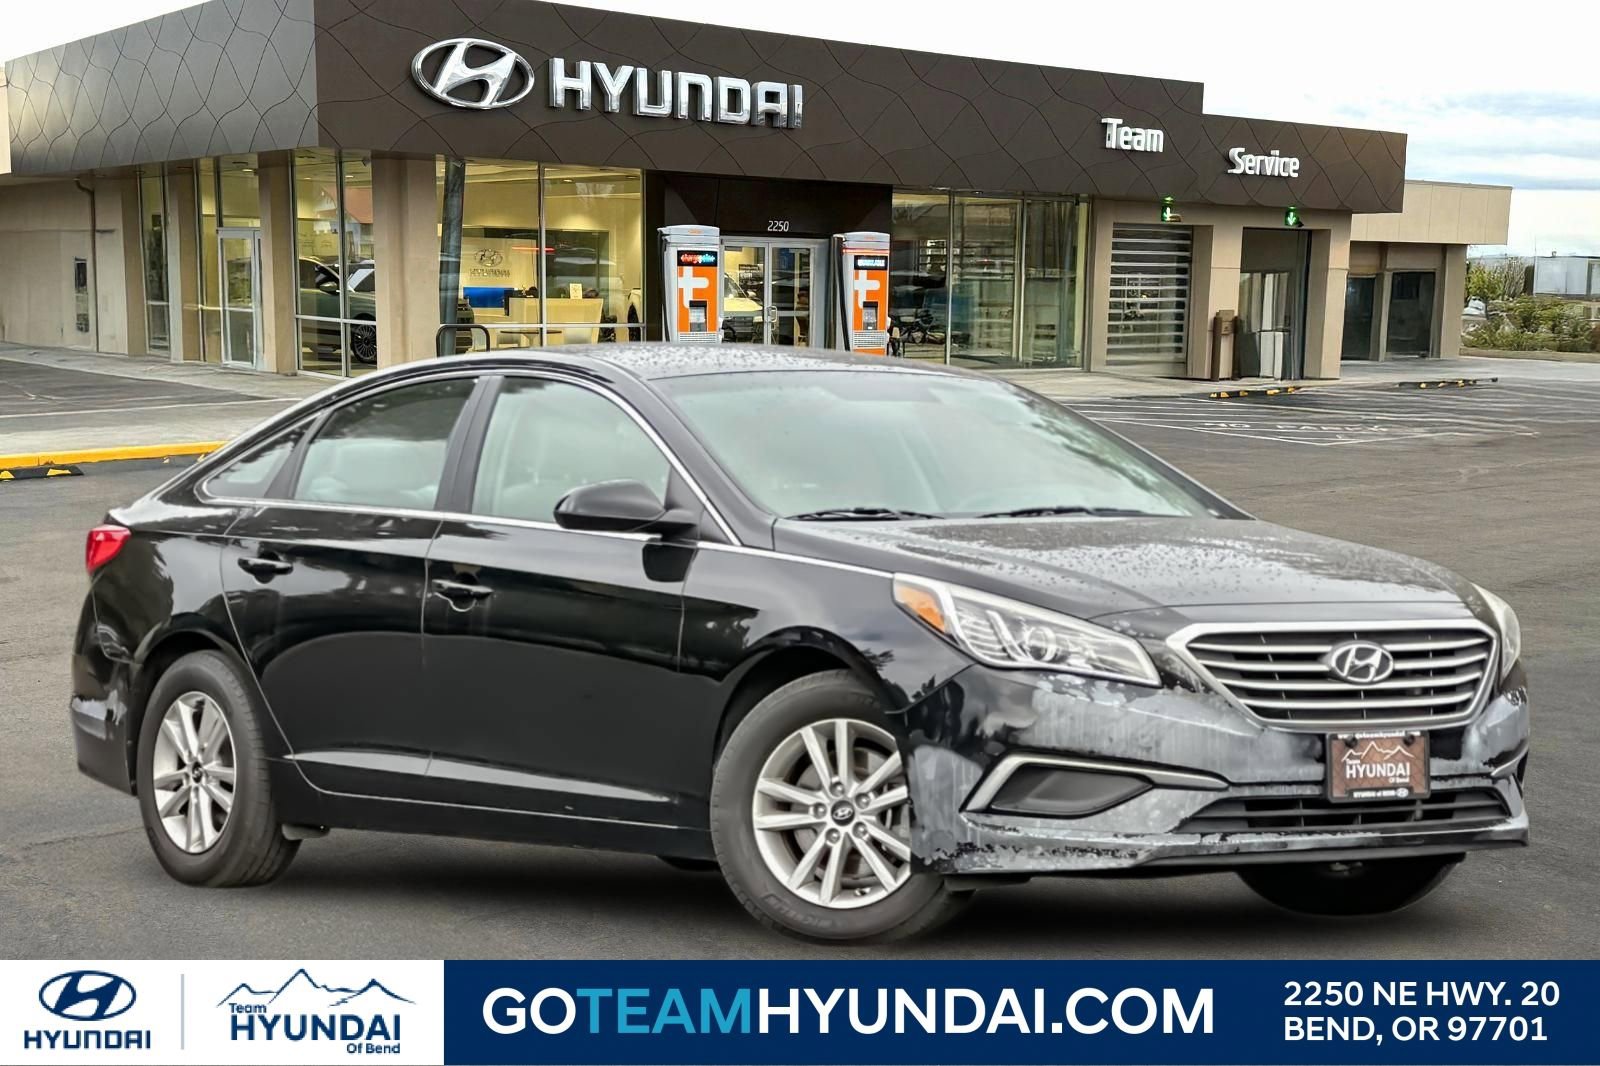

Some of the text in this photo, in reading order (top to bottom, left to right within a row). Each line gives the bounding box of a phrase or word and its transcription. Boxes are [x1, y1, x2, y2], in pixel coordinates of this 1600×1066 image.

[549, 57, 804, 128] HYUNDAI
[1102, 117, 1164, 153] Team
[1227, 147, 1300, 178] Service
[767, 220, 790, 232] 2250
[1346, 762, 1411, 780] HYUNDAI
